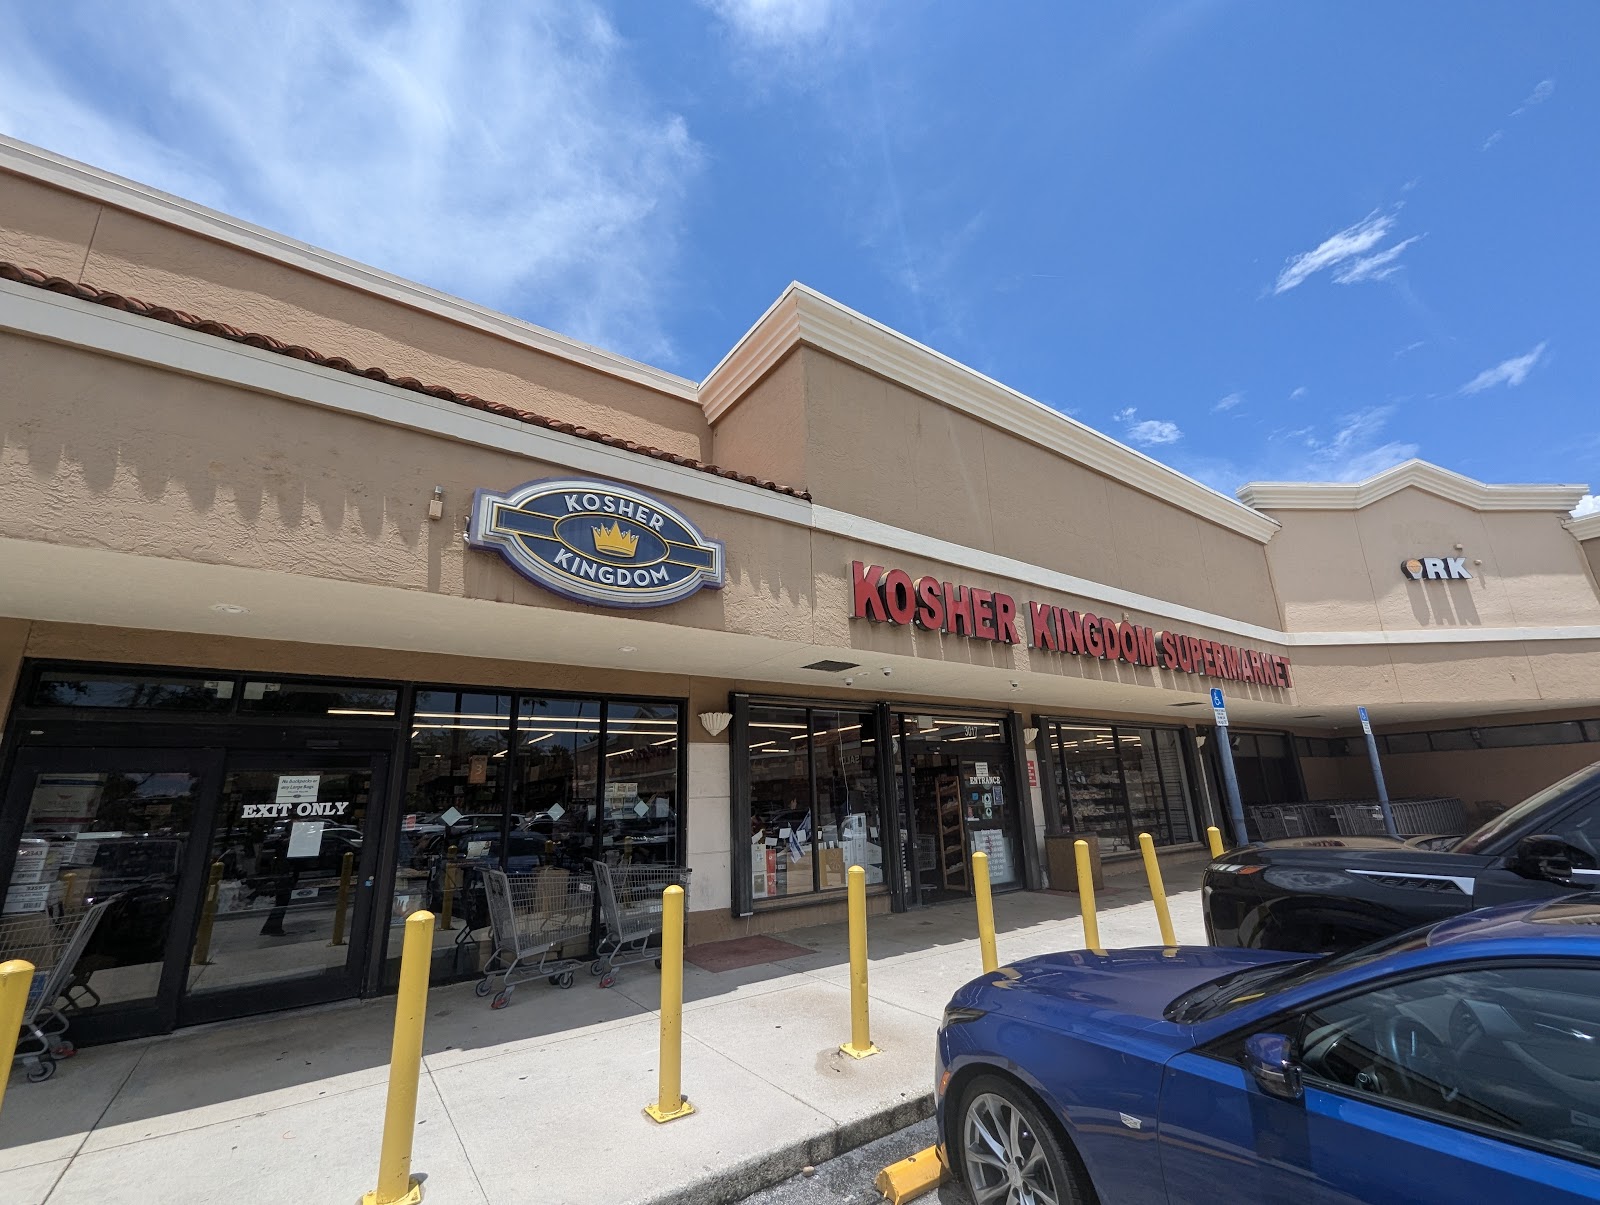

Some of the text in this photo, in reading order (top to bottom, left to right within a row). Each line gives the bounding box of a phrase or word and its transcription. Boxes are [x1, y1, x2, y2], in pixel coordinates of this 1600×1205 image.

[564, 493, 665, 532] KOSHER
[553, 547, 670, 587] KINGDOM
[852, 560, 1292, 688] KOSHER KINGDOM SUPERMARKET
[964, 725, 978, 738] 3017
[969, 776, 1001, 785] ENTRANCE
[241, 802, 349, 818] EXIT ONLY
